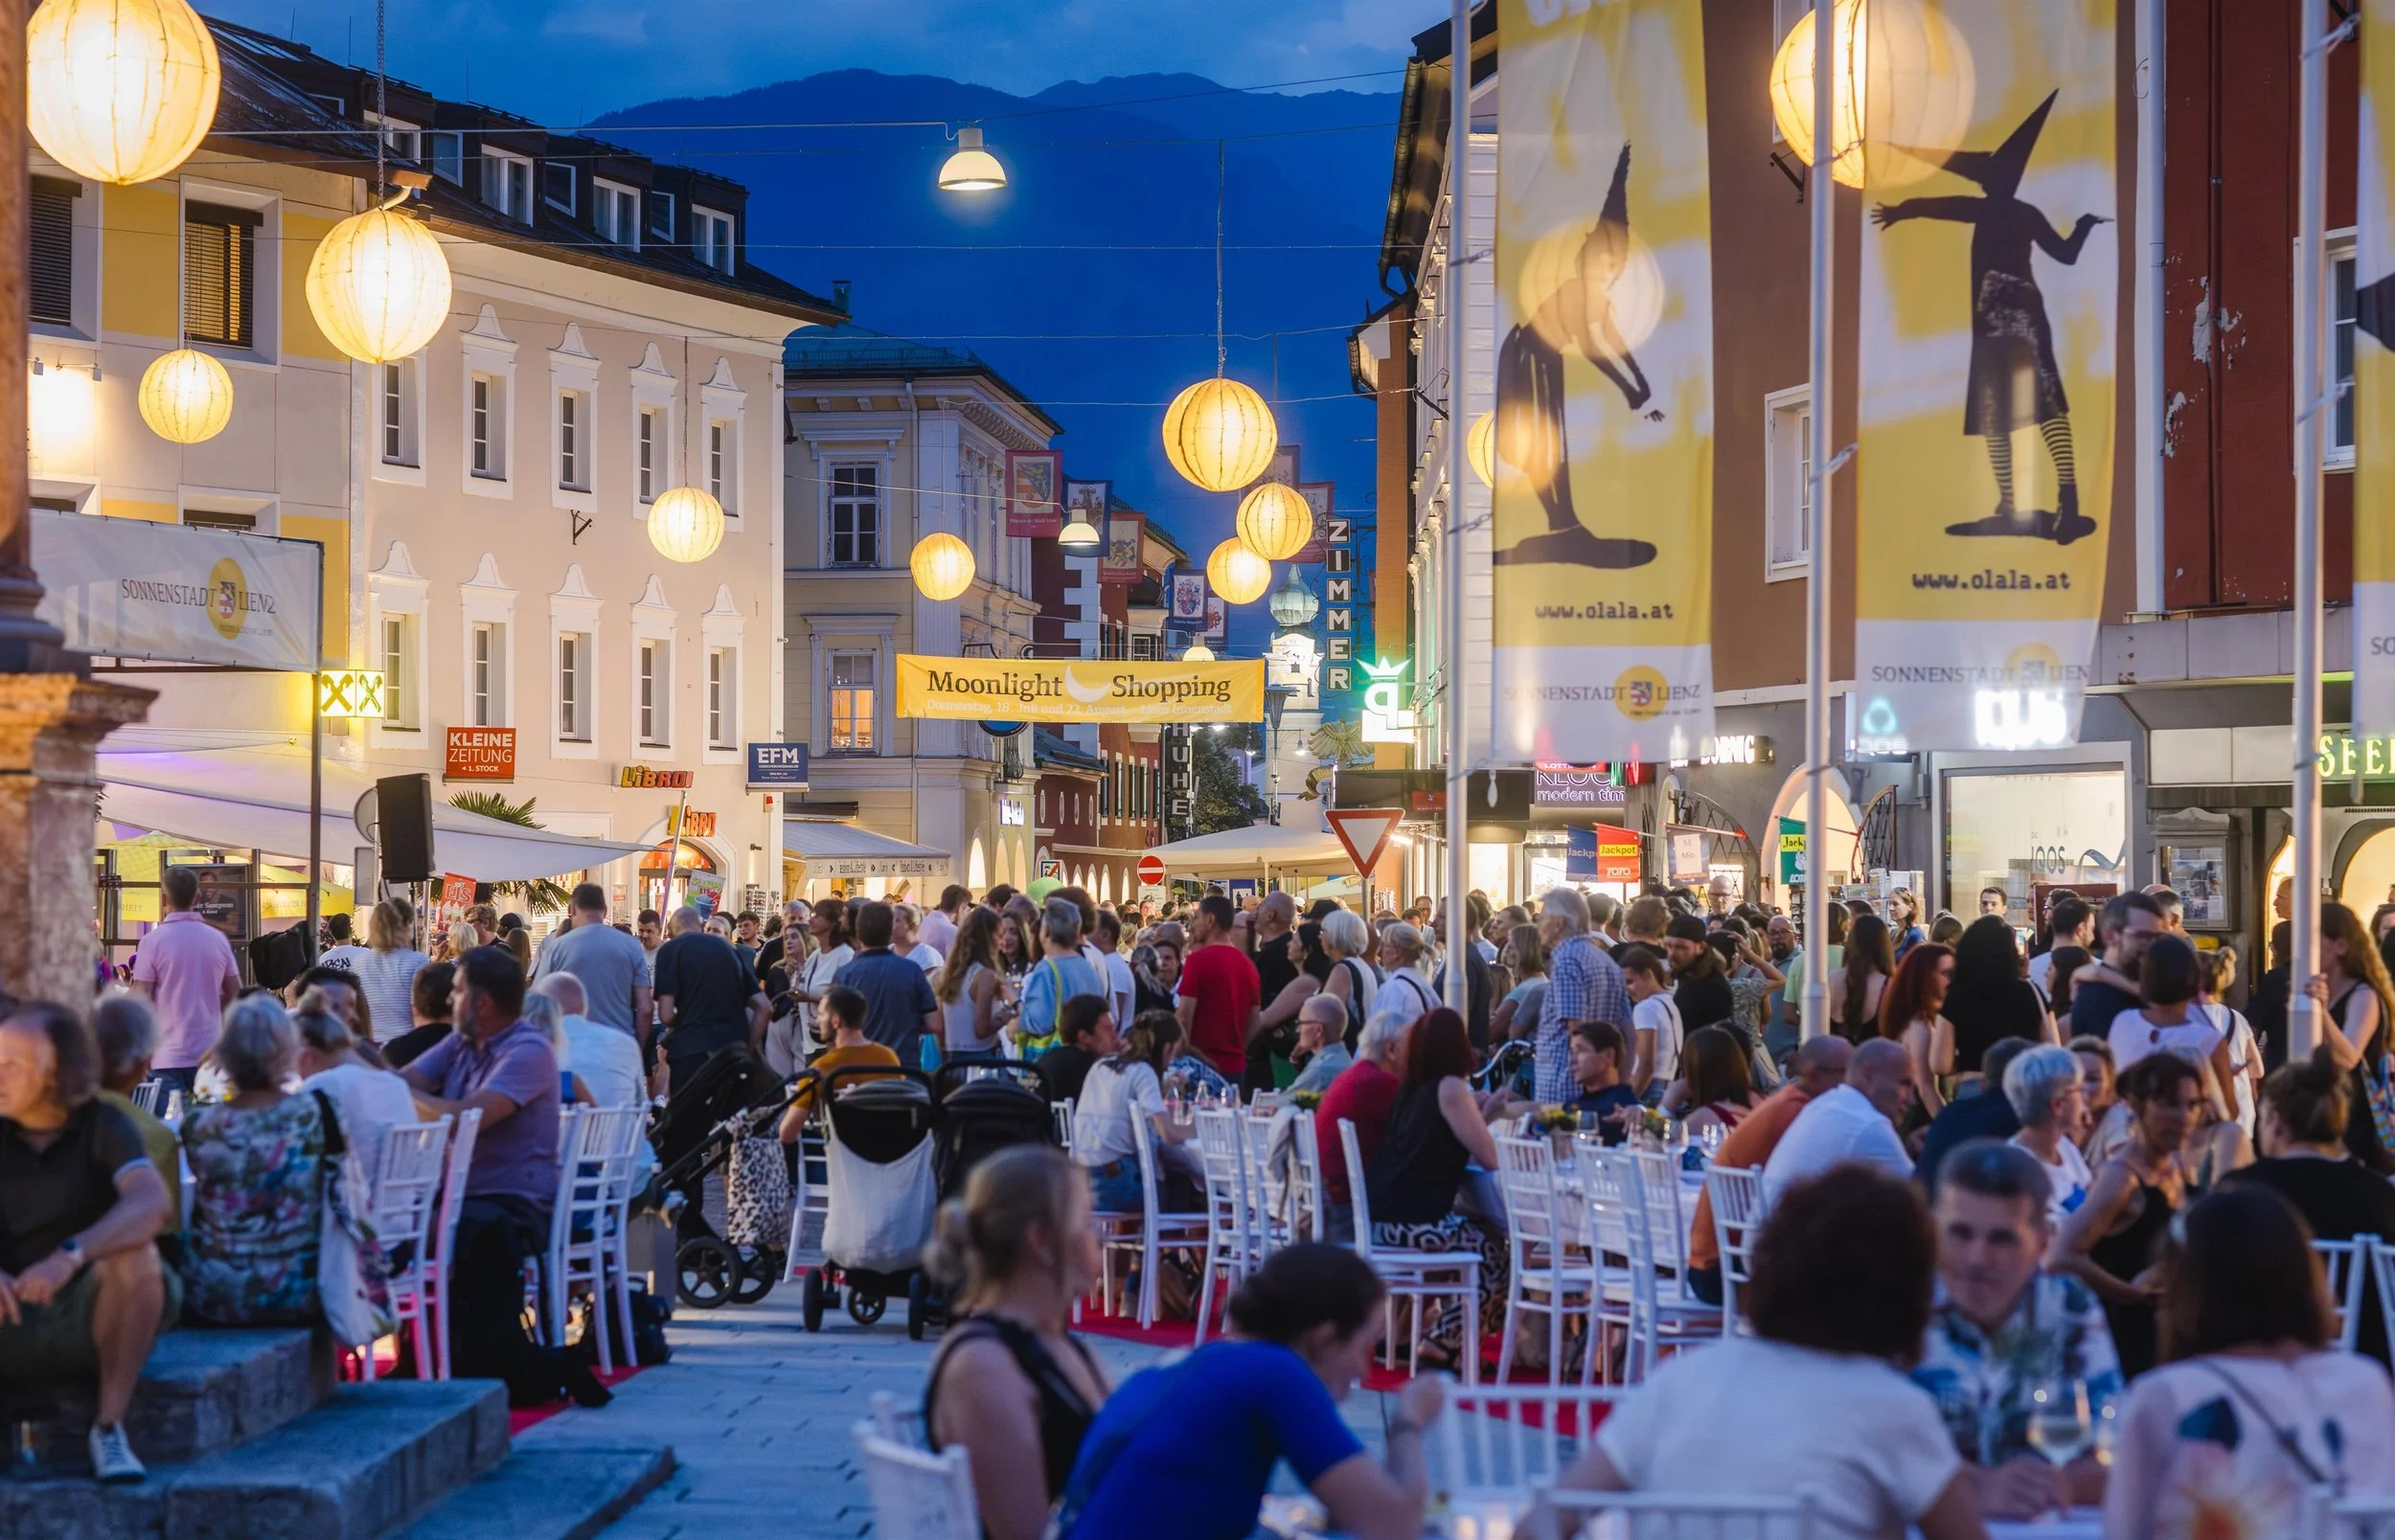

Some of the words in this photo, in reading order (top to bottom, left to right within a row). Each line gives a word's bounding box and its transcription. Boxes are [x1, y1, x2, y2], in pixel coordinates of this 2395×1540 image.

[1913, 569, 2071, 590] www.olala.at
[122, 578, 217, 607] SONNENSTADT
[1328, 521, 1349, 690] ZIMMER
[1535, 601, 1674, 620] www.olala.at
[927, 669, 1062, 702] Moonlight
[1112, 674, 1231, 702] Shopping
[1657, 683, 1701, 700] LIENZ
[449, 733, 513, 746] KLEINE
[448, 748, 513, 763] ZEITUNG
[757, 747, 800, 763] EFM
[1537, 787, 1594, 801] modern
[1598, 787, 1626, 802] tim
[1601, 847, 1636, 856] Jackpot
[2032, 846, 2066, 874] IQOS
[1607, 867, 1631, 875] TOTO
[445, 885, 472, 904] EIS
